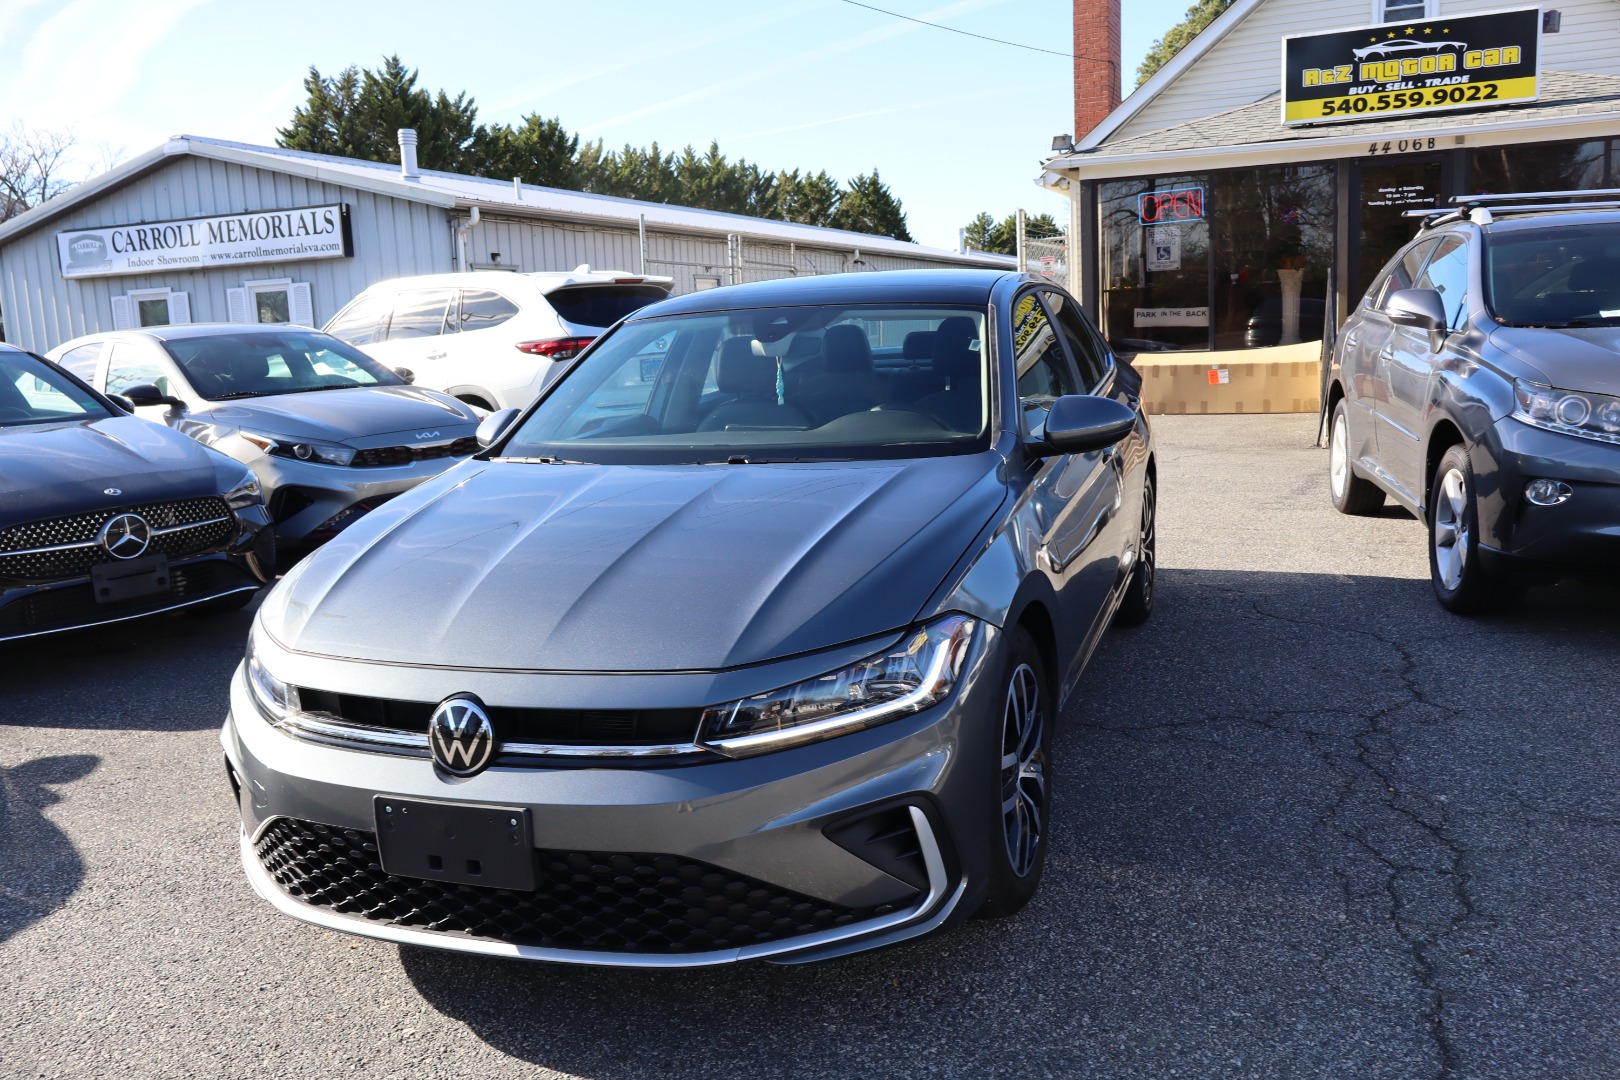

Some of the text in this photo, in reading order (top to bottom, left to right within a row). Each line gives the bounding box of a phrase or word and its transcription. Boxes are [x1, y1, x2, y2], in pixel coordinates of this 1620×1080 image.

[1322, 84, 1498, 116] 540.559.9022
[1348, 85, 1377, 95] BUY
[1385, 81, 1415, 92] SELL
[1425, 75, 1470, 87] TRADE
[1141, 190, 1202, 222] OPEN
[112, 209, 335, 254] CARROLL MEMORIALS
[127, 257, 154, 268] Indoor
[157, 254, 200, 266] Showroom
[210, 242, 341, 261] www.carrollmemorialsva.com
